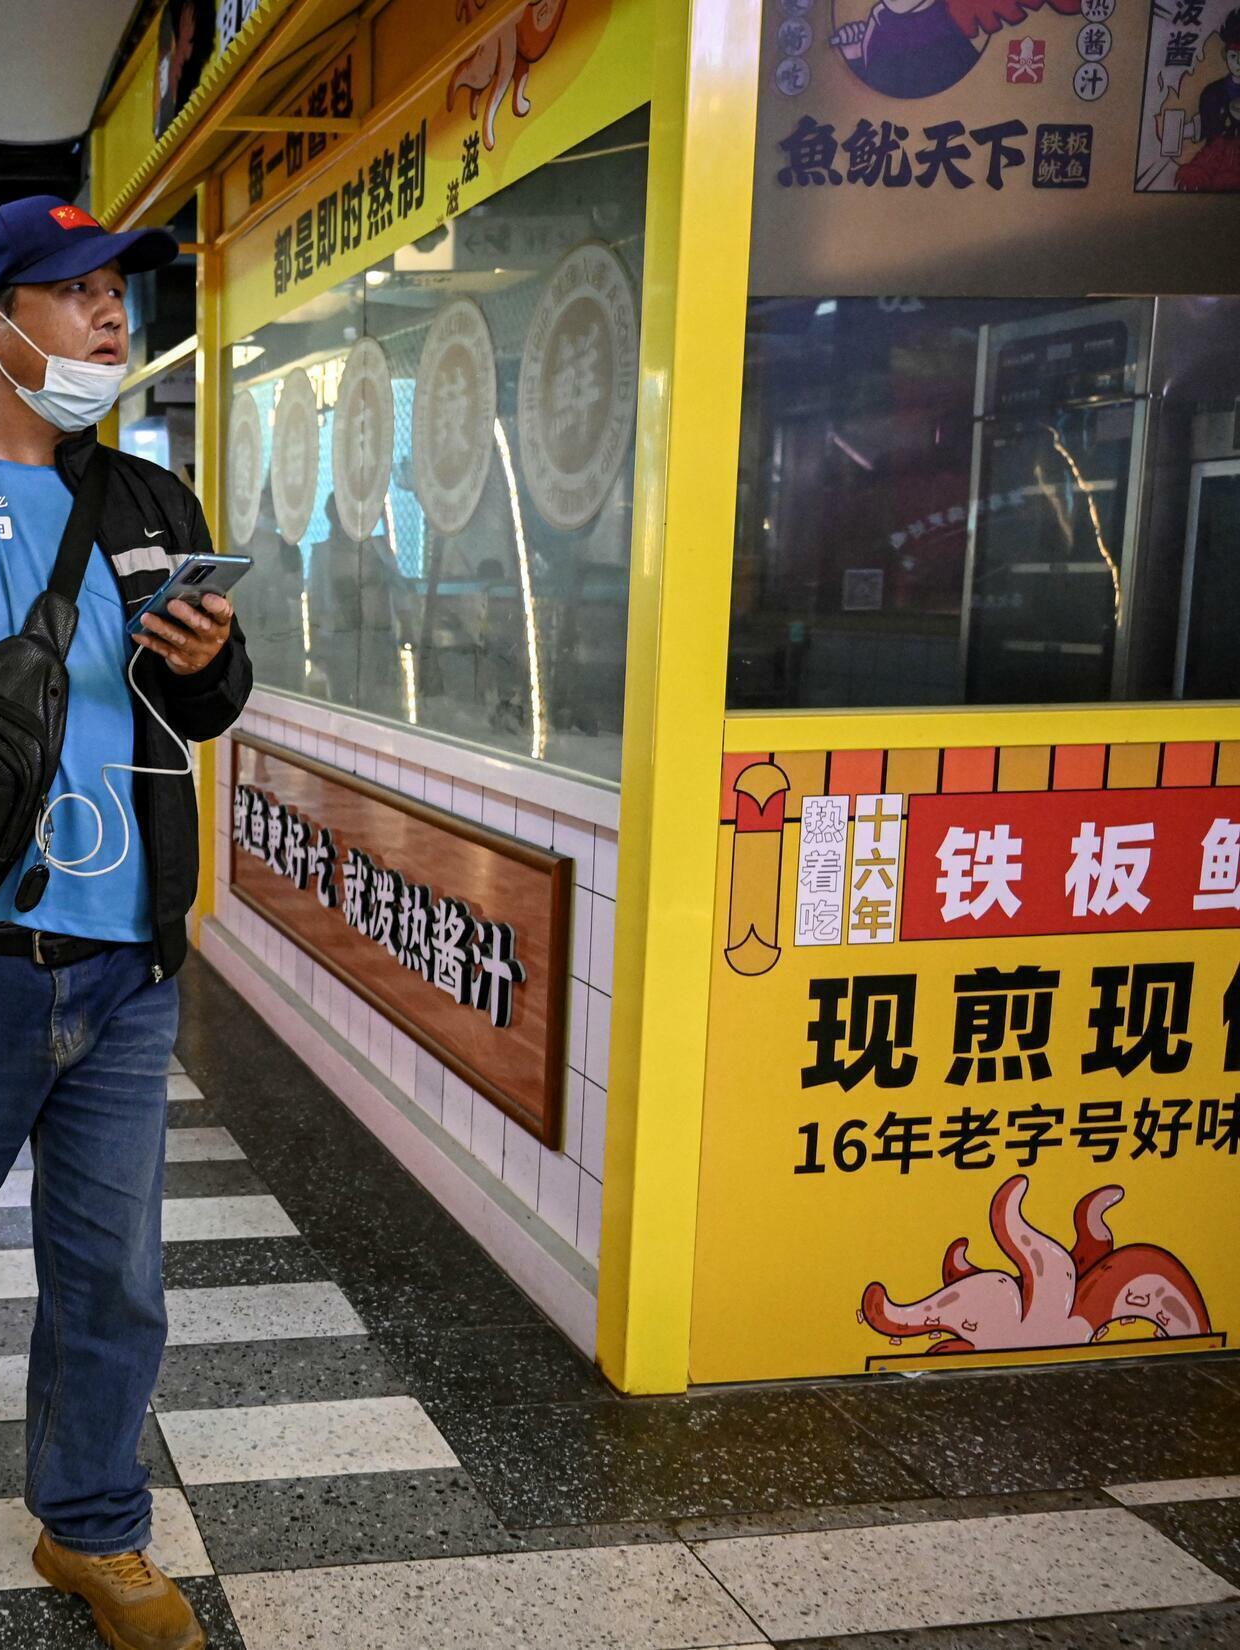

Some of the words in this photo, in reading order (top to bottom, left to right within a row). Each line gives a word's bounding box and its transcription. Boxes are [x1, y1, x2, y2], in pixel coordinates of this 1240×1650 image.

[274, 118, 427, 298] 都是即时熬制
[1037, 159, 1087, 183] 鱿鱼
[1041, 132, 1090, 155] 铁板
[233, 784, 337, 908] 鱿鱼更好吃
[342, 848, 525, 1028] 就泼热酱汁
[799, 800, 845, 941] 热着吃
[851, 798, 899, 939] 十六年
[801, 961, 1240, 1092] 现煎现
[794, 1092, 1240, 1175] 16年老字号好味
